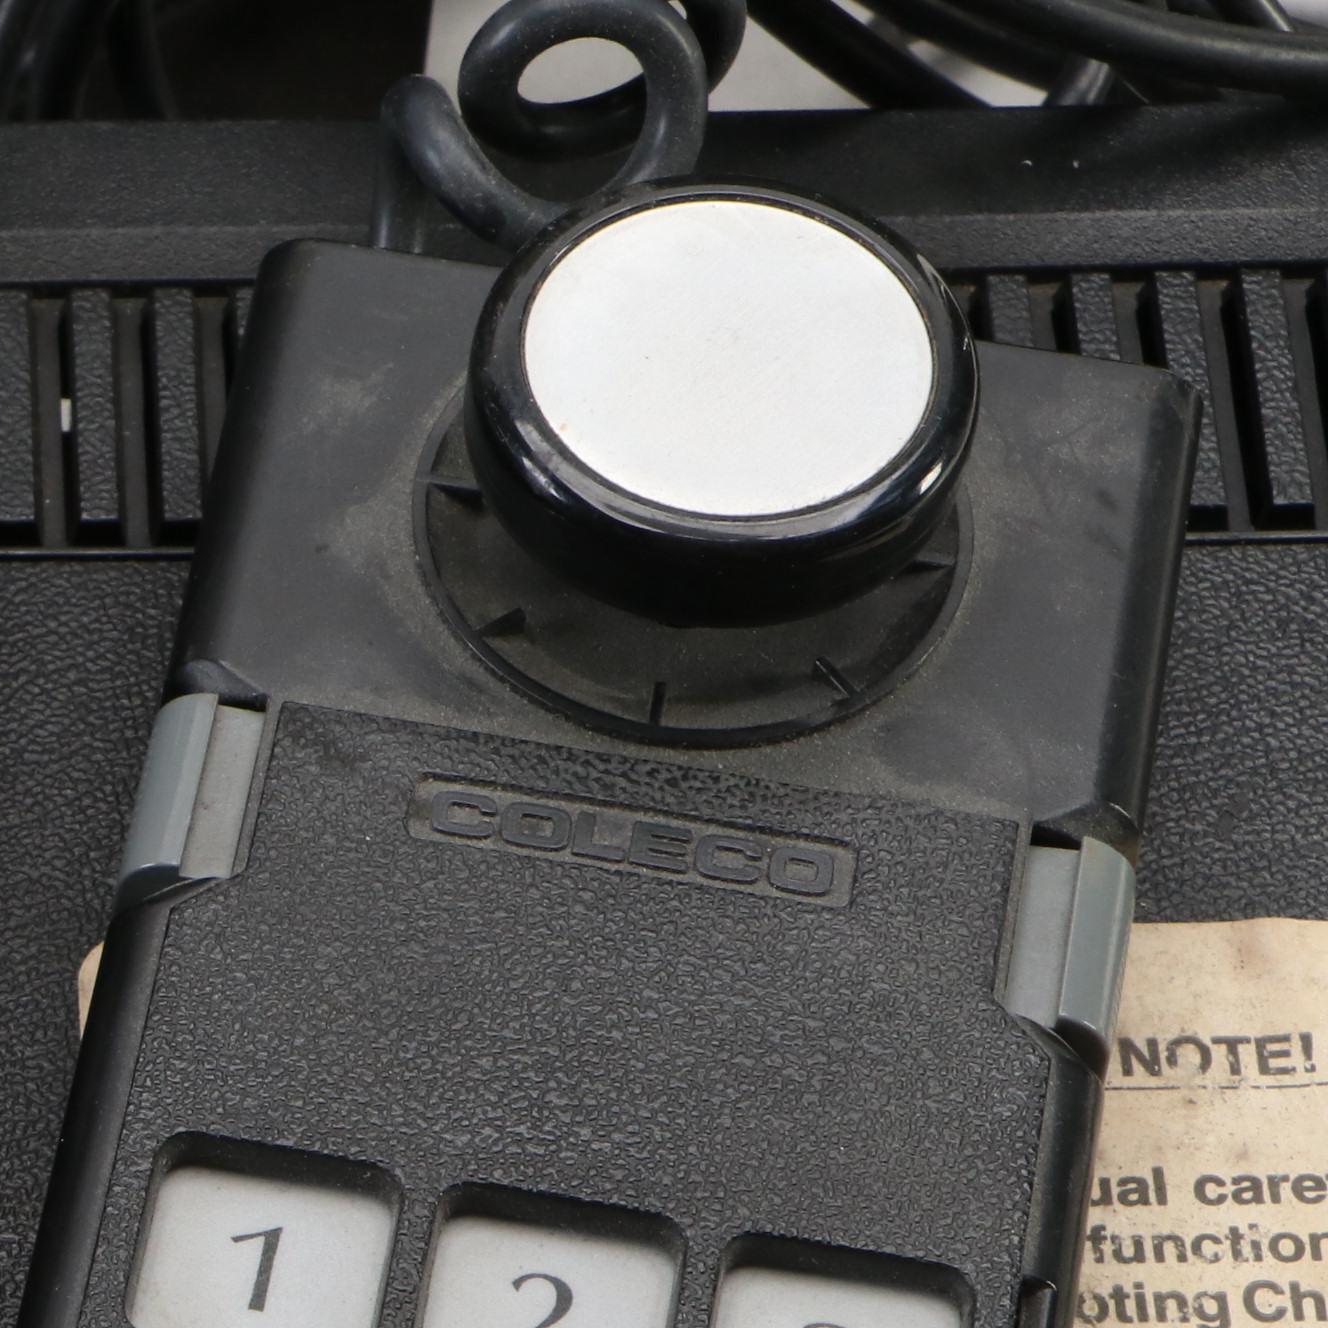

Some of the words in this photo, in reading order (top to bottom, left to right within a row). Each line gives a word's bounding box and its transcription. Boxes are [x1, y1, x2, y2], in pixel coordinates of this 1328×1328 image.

[430, 789, 835, 898] COLECO
[1118, 1031, 1317, 1077] NOTE!
[1193, 1172, 1328, 1207] care
[232, 1227, 282, 1311] 1
